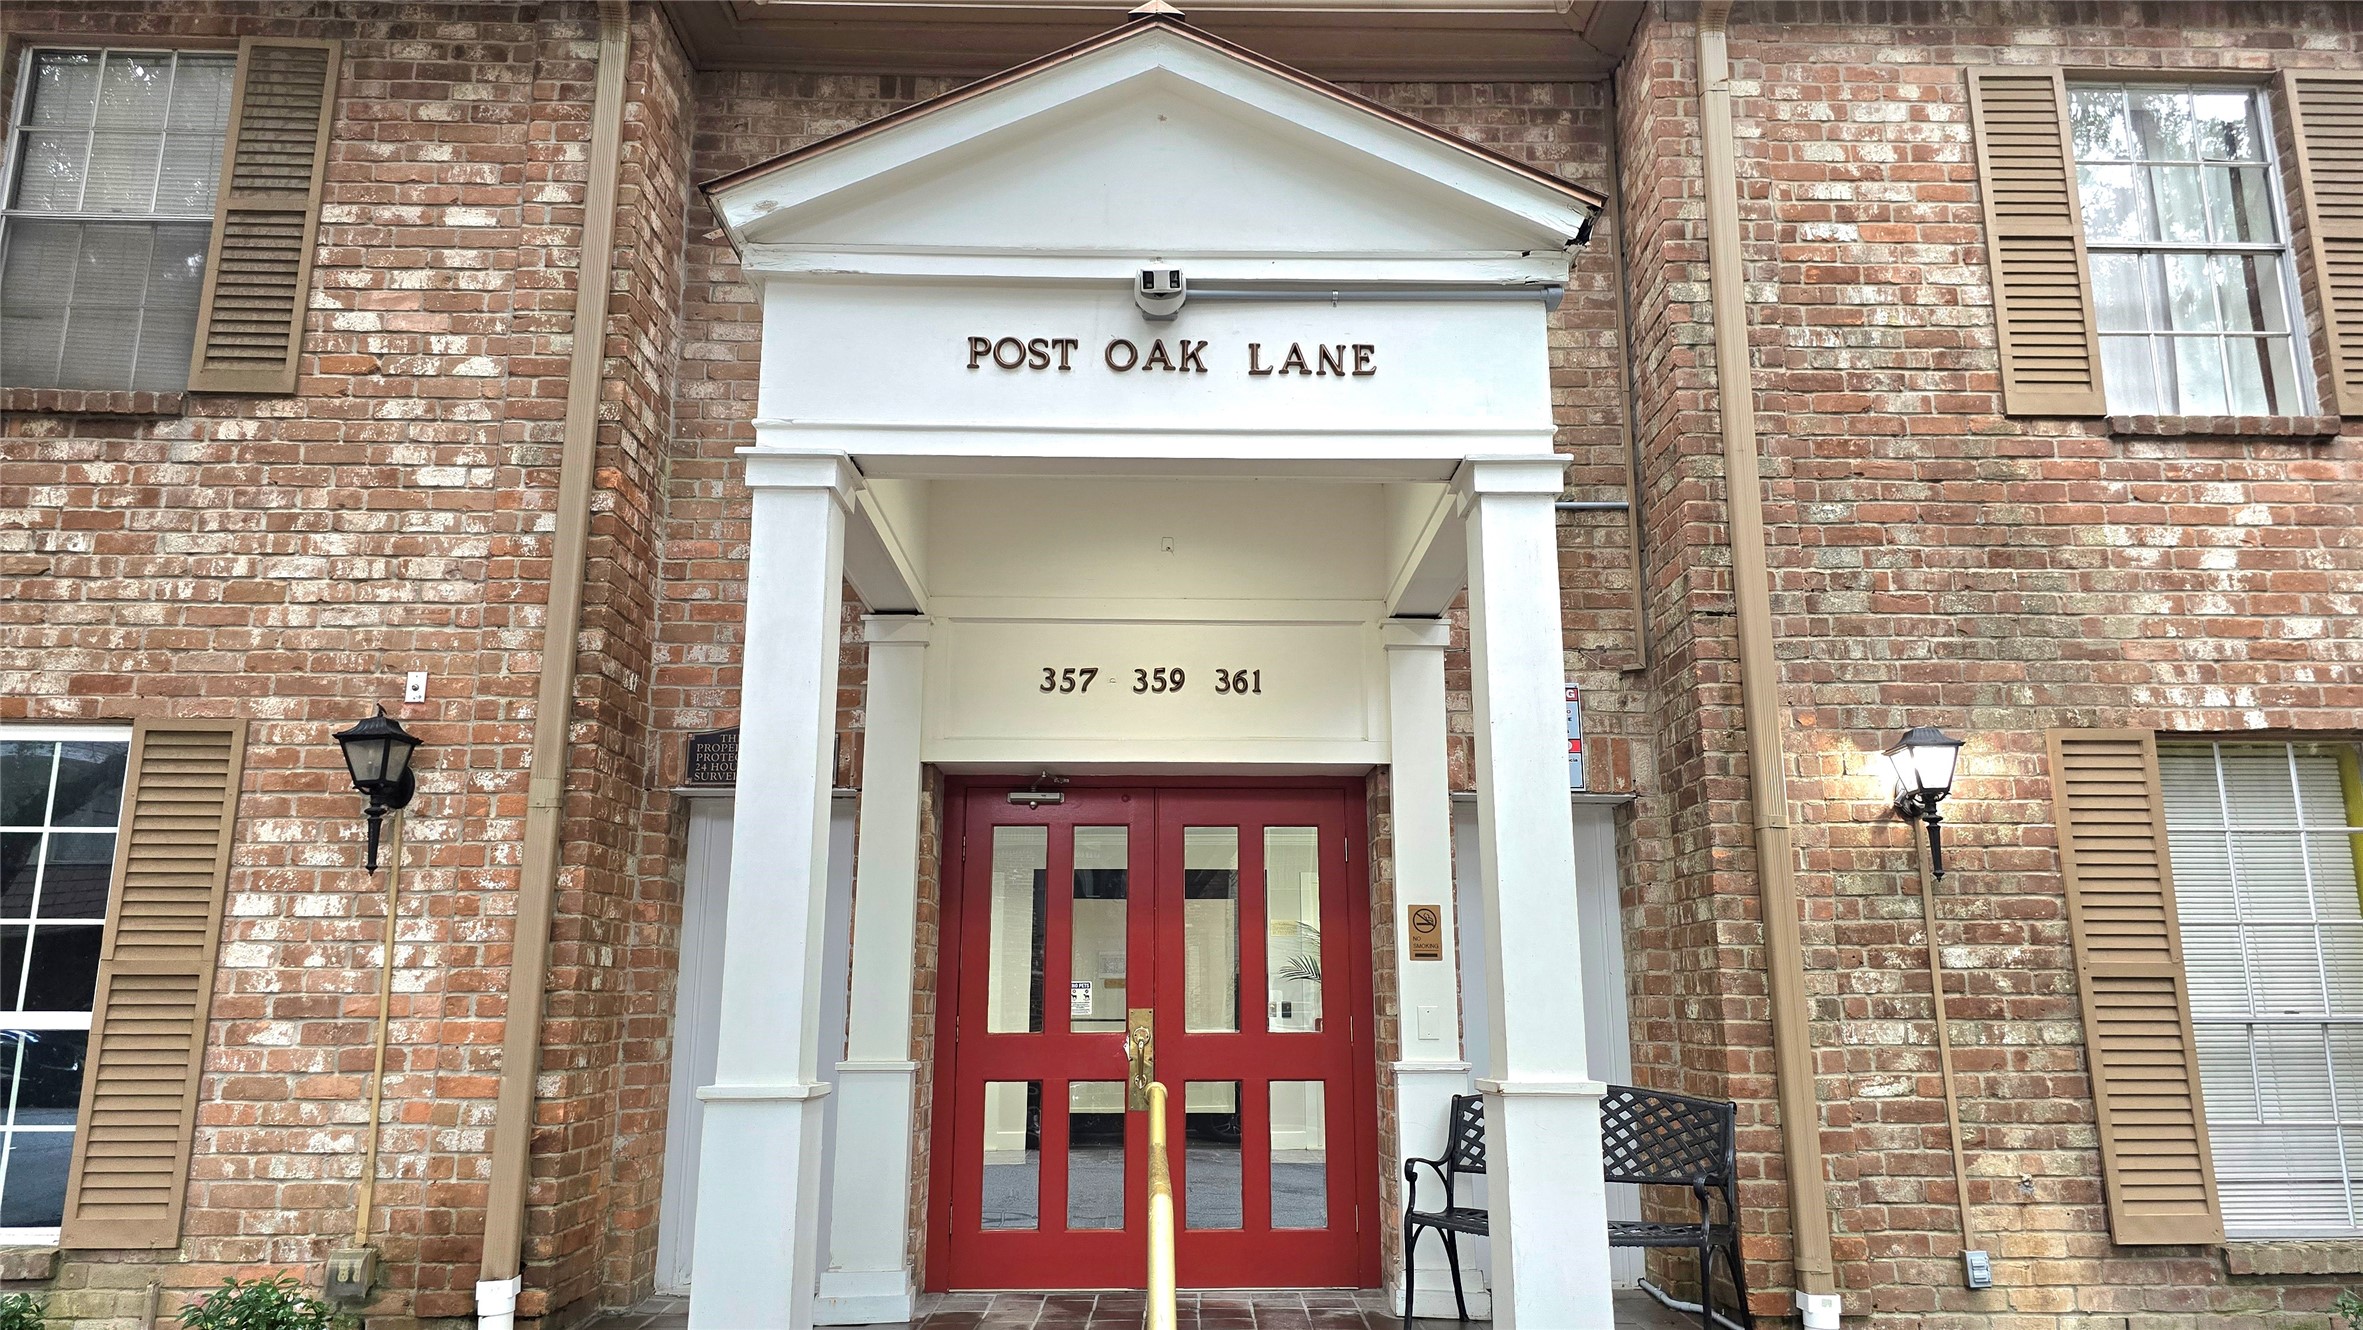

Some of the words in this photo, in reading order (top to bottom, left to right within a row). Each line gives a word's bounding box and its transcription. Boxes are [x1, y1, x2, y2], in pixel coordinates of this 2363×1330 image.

[966, 336, 1079, 371] POST
[1104, 338, 1209, 373] OAK
[1247, 341, 1378, 377] LANE
[1039, 667, 1099, 694] 357
[1132, 667, 1186, 694] 359
[1215, 668, 1262, 695] 361
[695, 762, 707, 771] 24
